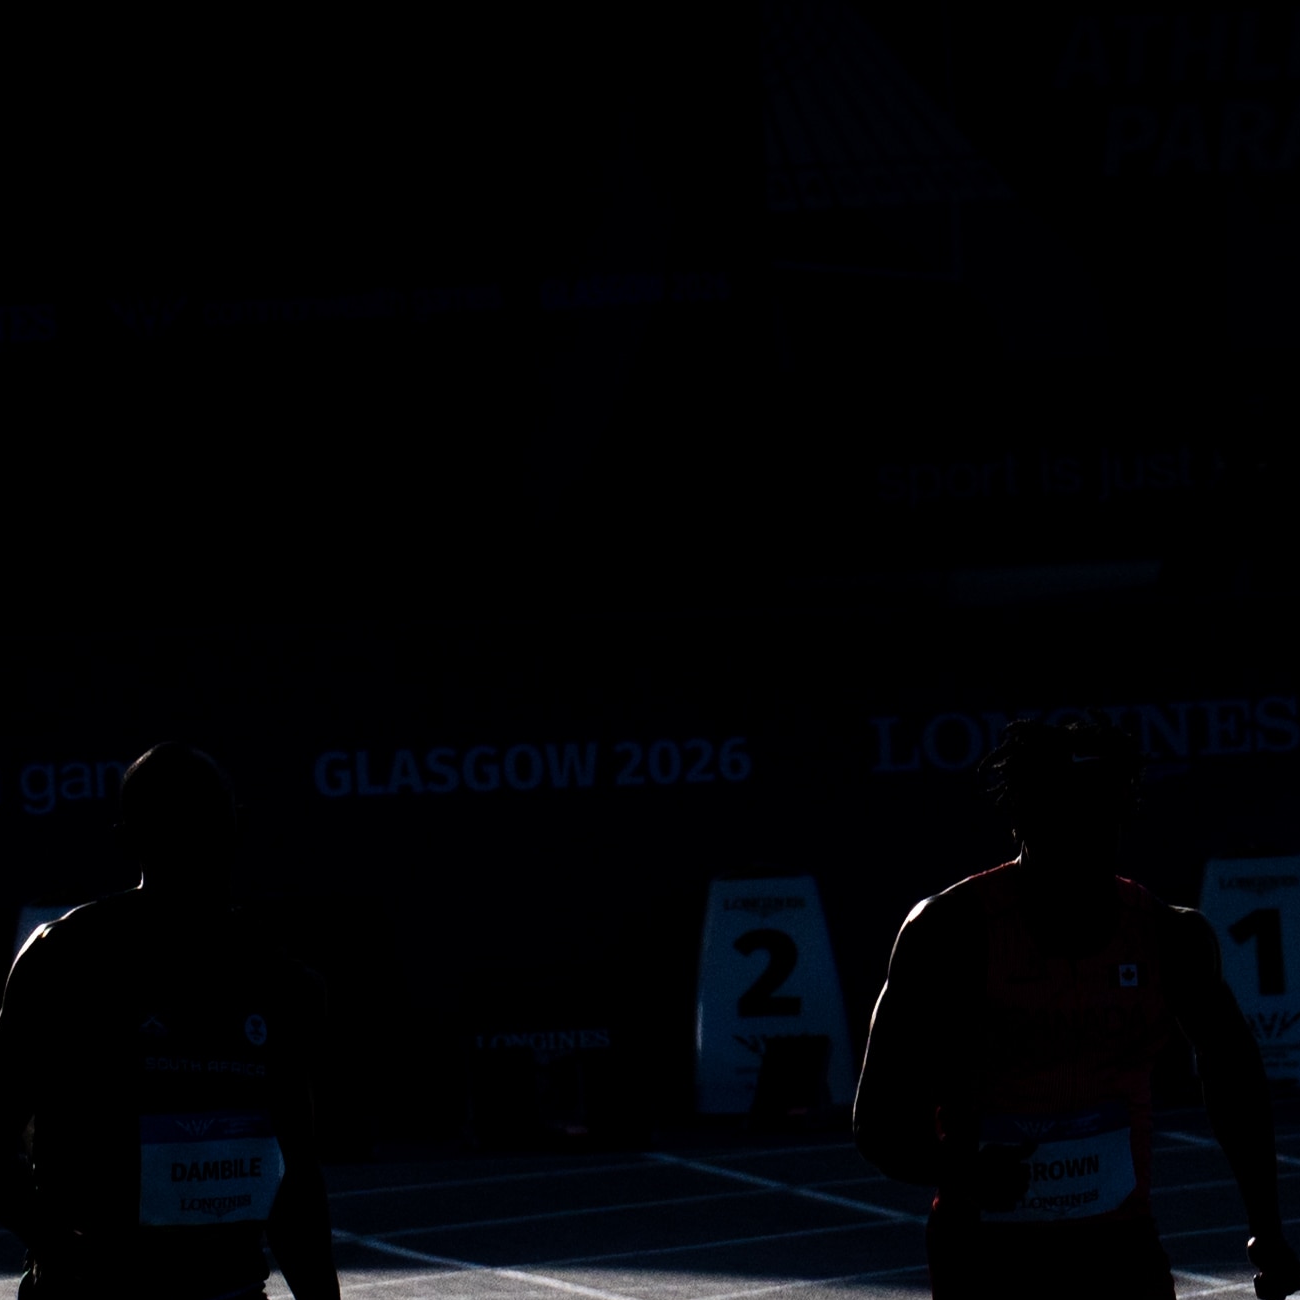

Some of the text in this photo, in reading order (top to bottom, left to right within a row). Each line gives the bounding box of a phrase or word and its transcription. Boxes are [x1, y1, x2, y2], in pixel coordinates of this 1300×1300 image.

[202, 282, 505, 327] commonwealth games
[538, 275, 663, 311] GLASGOW
[876, 450, 1020, 509] sport
[1039, 446, 1083, 494] is
[1098, 440, 1196, 503] just
[312, 736, 751, 798] GLASGOW 2026
[733, 928, 802, 1018] 2
[1228, 907, 1286, 996] 1
[144, 1056, 266, 1078] SOUTH AFRICA
[171, 1157, 262, 1183] DAMBILE
[1029, 1155, 1100, 1183] ROWN
